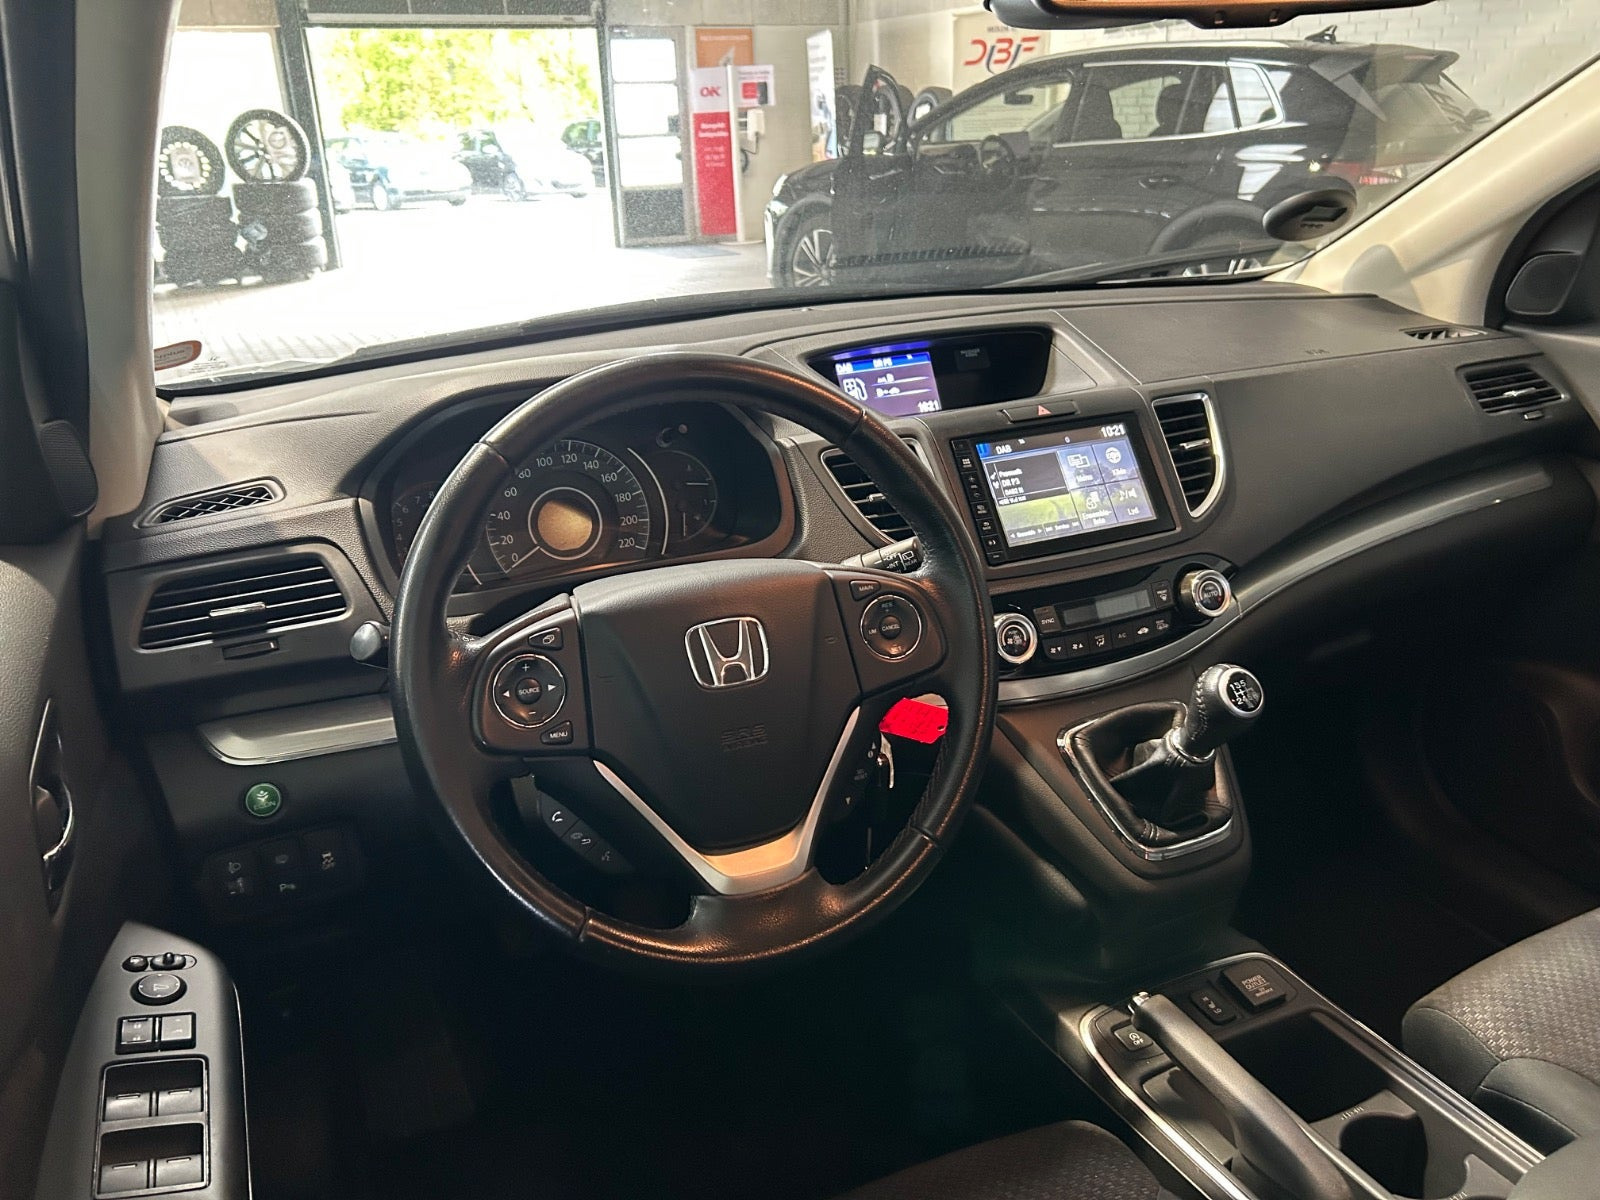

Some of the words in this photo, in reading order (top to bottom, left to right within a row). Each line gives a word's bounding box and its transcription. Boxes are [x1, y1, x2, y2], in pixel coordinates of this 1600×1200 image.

[700, 86, 721, 97] OK
[995, 444, 1012, 455] DAB
[536, 456, 553, 467] 100
[561, 453, 578, 464] 120
[583, 460, 600, 471] 140
[601, 472, 618, 483] 160
[504, 486, 517, 498] 60
[615, 492, 632, 503] 180
[402, 506, 409, 514] 6
[497, 510, 511, 521] 40
[620, 515, 638, 526] 200
[501, 534, 514, 545] 20
[619, 537, 635, 549] 220
[512, 553, 519, 562] 0
[1041, 617, 1055, 625] SYNC
[518, 687, 540, 695] SOURCE
[1236, 697, 1244, 705] 2
